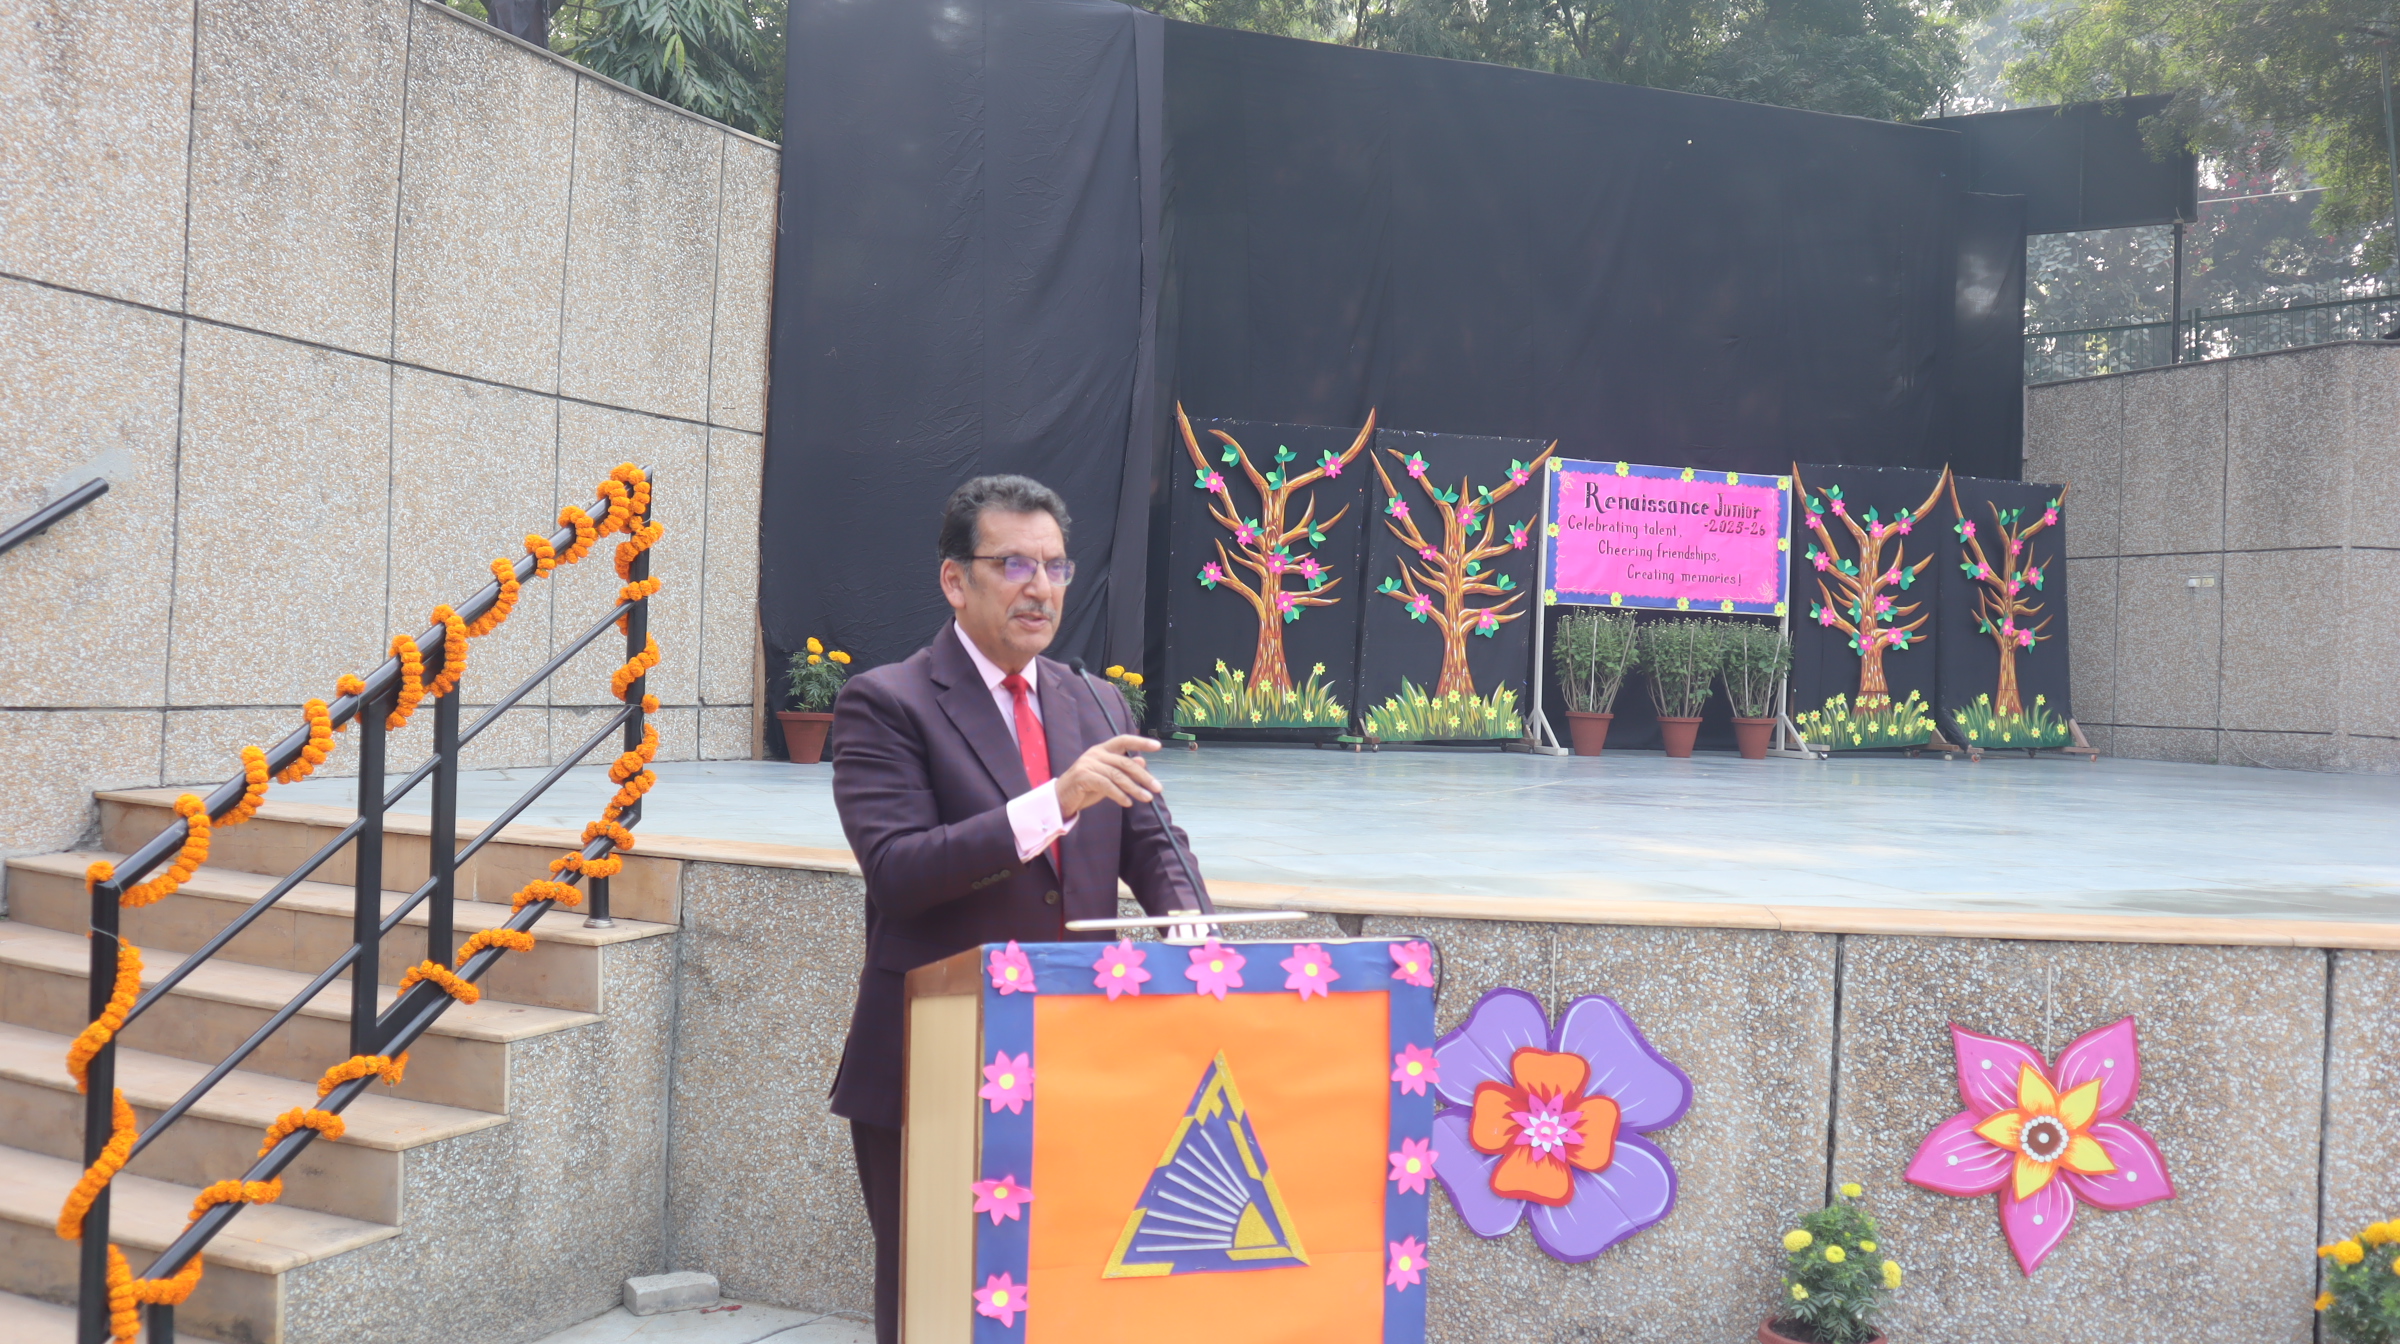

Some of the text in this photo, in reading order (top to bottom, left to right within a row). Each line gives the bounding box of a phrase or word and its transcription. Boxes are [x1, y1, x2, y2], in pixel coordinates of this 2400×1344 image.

[1584, 481, 1762, 520] Renaissance Junior
[1567, 515, 1682, 540] Celebrating talent,
[1598, 539, 1720, 565] Cheering friendships,
[1627, 564, 1742, 587] Creating memories!
